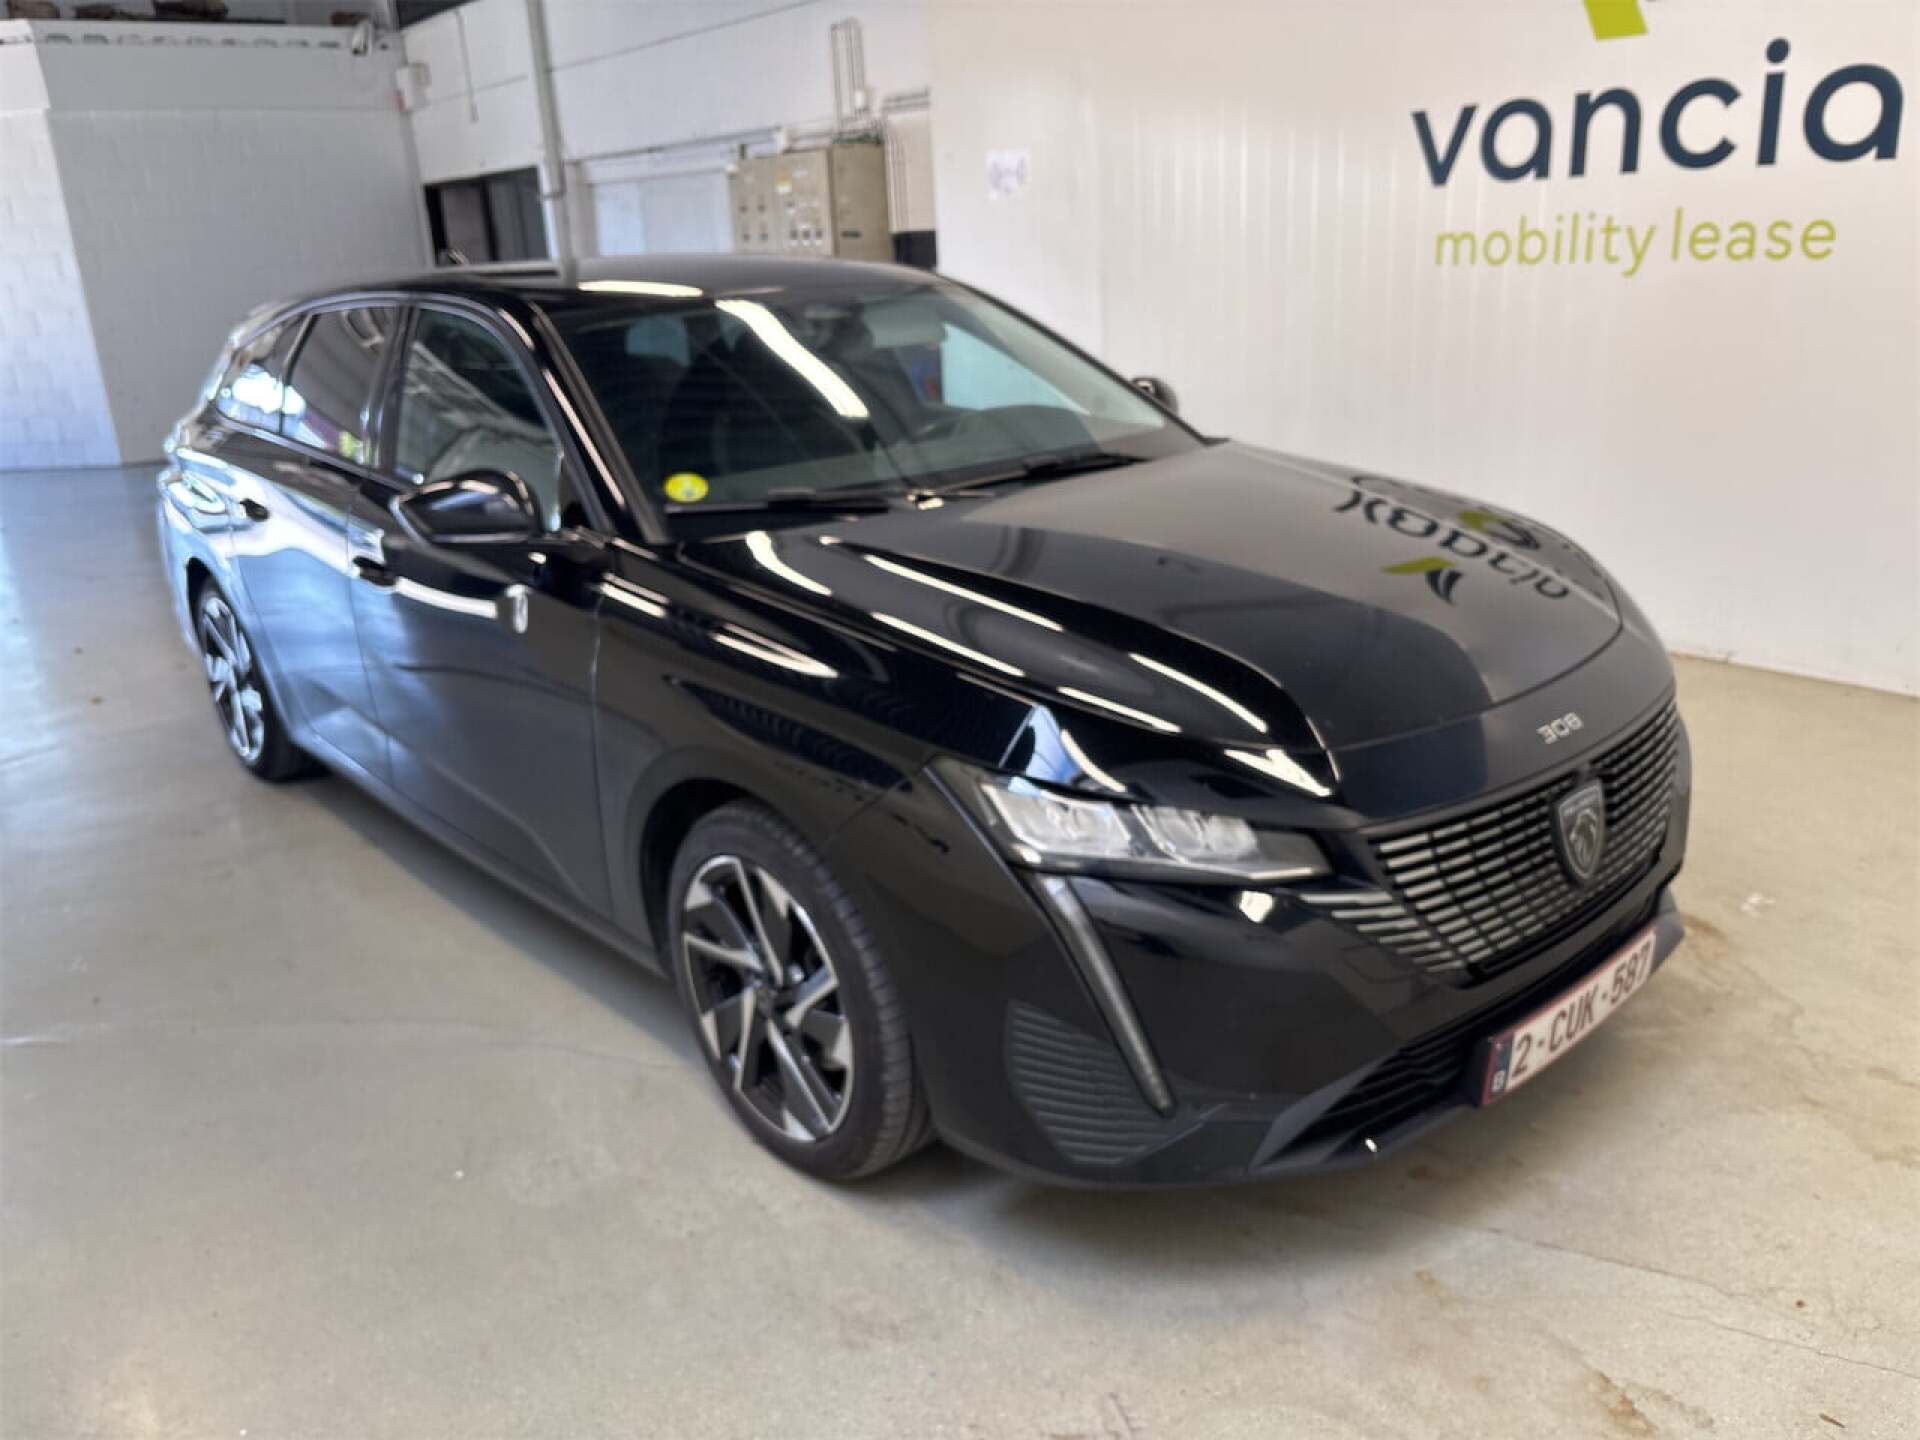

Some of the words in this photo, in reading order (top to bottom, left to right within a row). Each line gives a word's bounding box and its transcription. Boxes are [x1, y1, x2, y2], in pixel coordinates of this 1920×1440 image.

[1412, 38, 1904, 186] vancia
[1436, 212, 1656, 277] mobility
[1671, 208, 1838, 262] lease
[1537, 712, 1582, 744] 308
